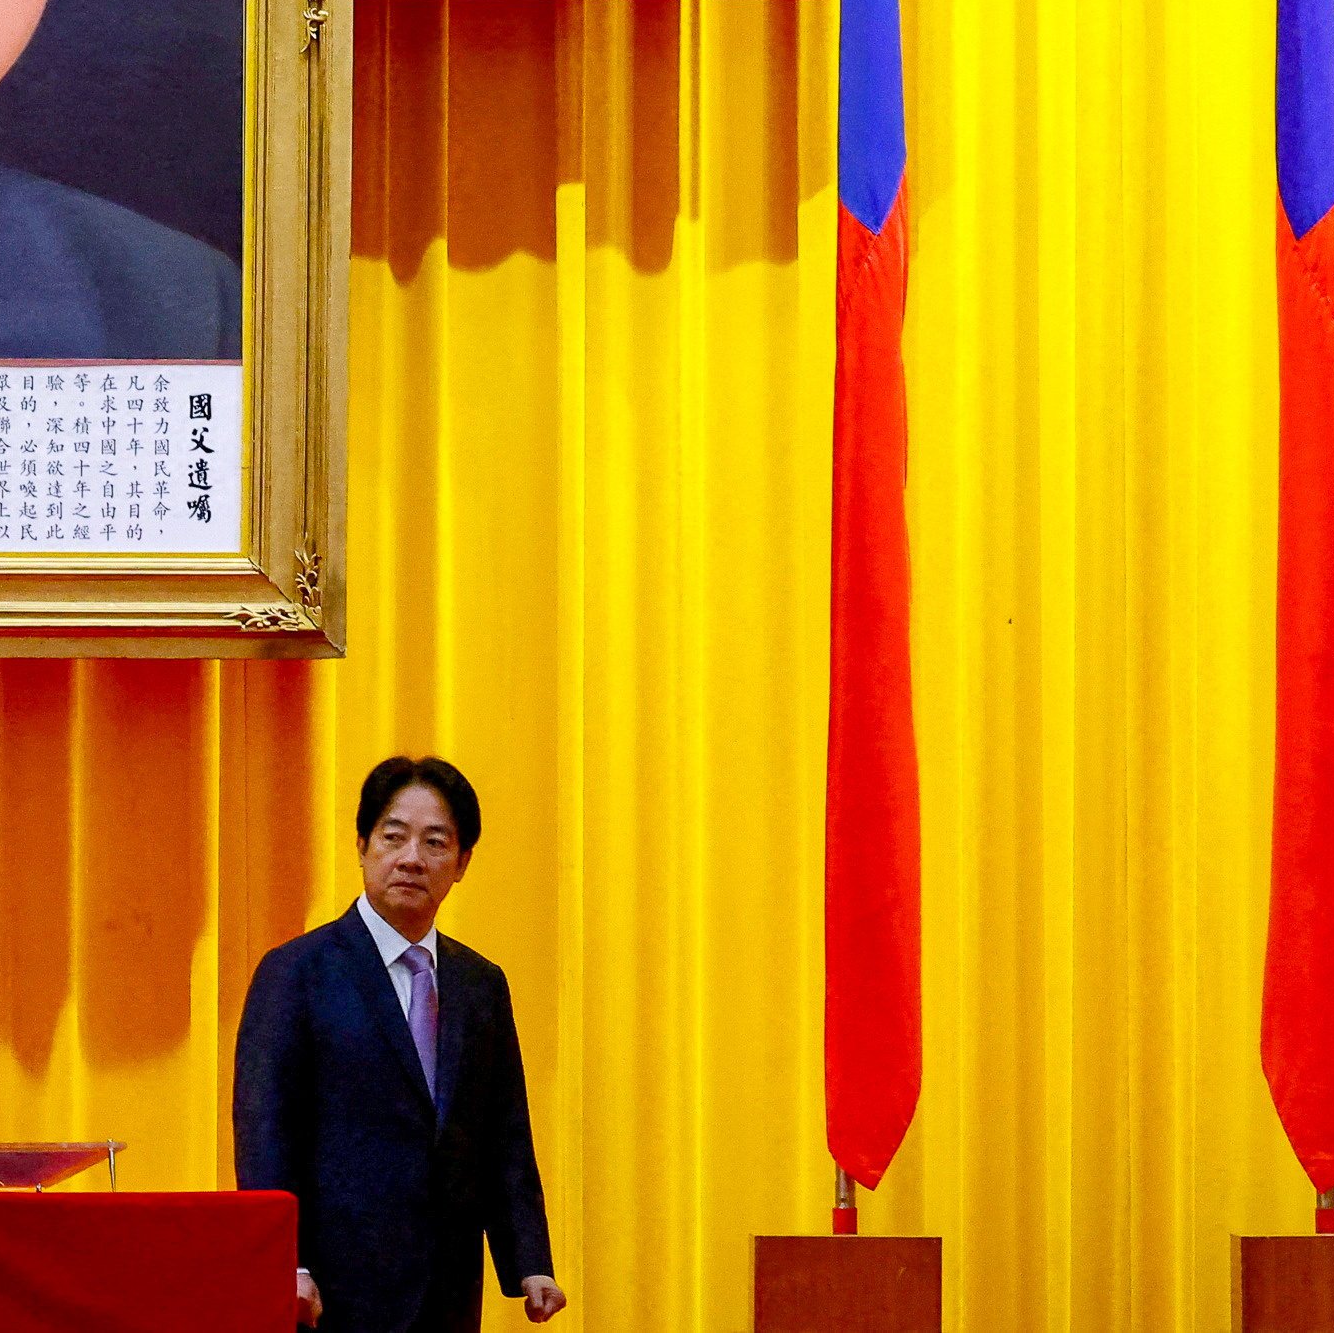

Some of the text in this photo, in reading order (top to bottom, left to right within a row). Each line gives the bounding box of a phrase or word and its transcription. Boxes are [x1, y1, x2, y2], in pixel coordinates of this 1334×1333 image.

[72, 373, 92, 540] 等。積四十年之經
[99, 373, 118, 542] 在求中國之自由平
[186, 392, 216, 524] 國父遺囑
